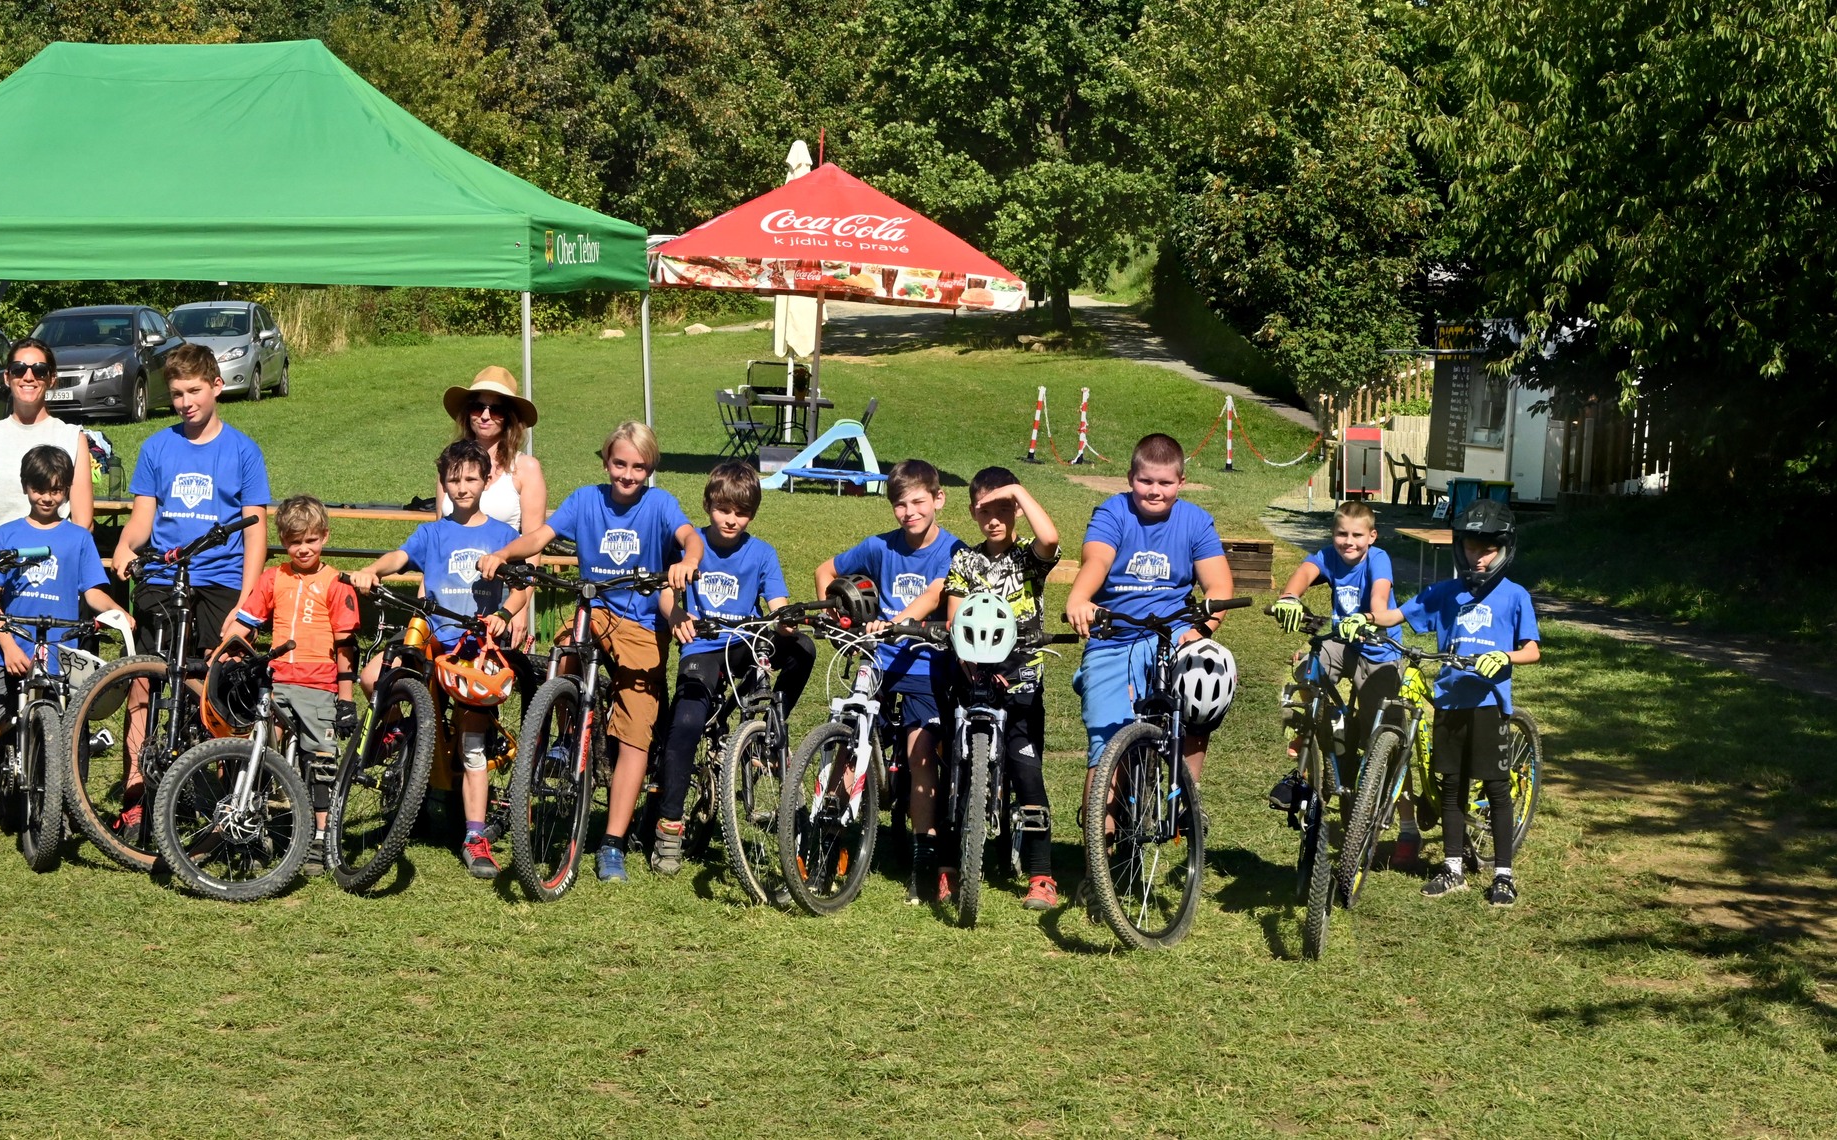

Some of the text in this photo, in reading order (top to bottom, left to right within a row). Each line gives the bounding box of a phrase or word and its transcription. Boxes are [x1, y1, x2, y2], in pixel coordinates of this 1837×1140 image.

[759, 208, 913, 243] Coca-Cola
[556, 232, 601, 265] Obec Tehov
[773, 235, 910, 255] k jídlu to pravé
[195, 513, 219, 522] RIDER
